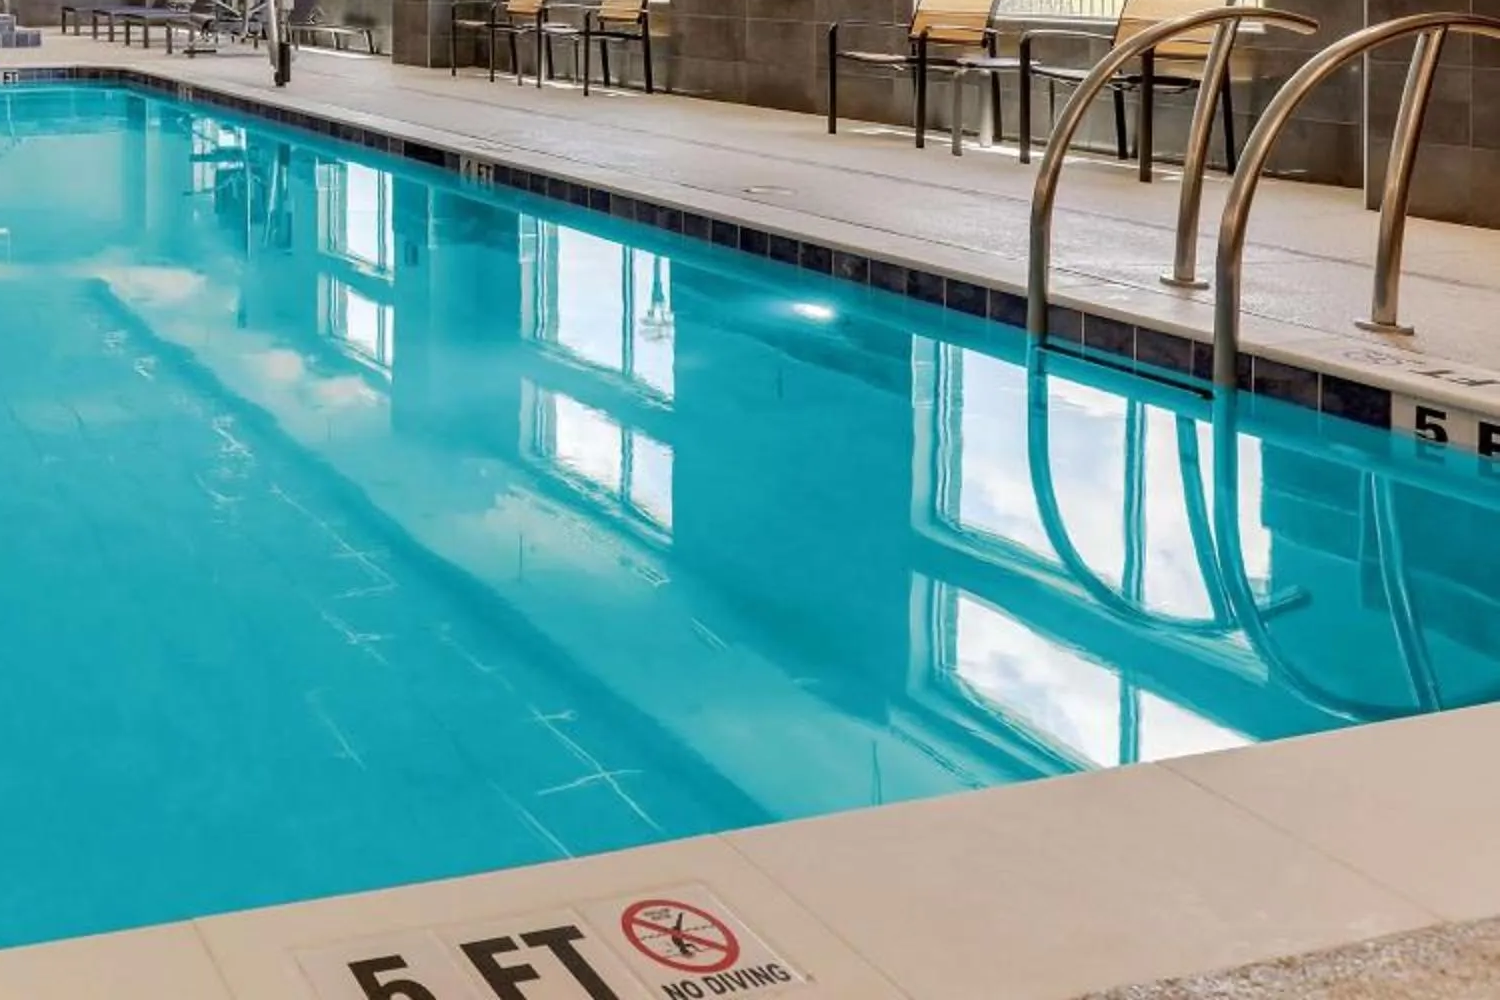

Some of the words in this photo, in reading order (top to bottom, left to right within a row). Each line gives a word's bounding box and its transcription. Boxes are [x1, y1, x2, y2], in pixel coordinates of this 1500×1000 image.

[1415, 405, 1449, 443] 5
[1478, 421, 1500, 458] F
[661, 980, 705, 1000] NO
[701, 963, 791, 996] DIVING
